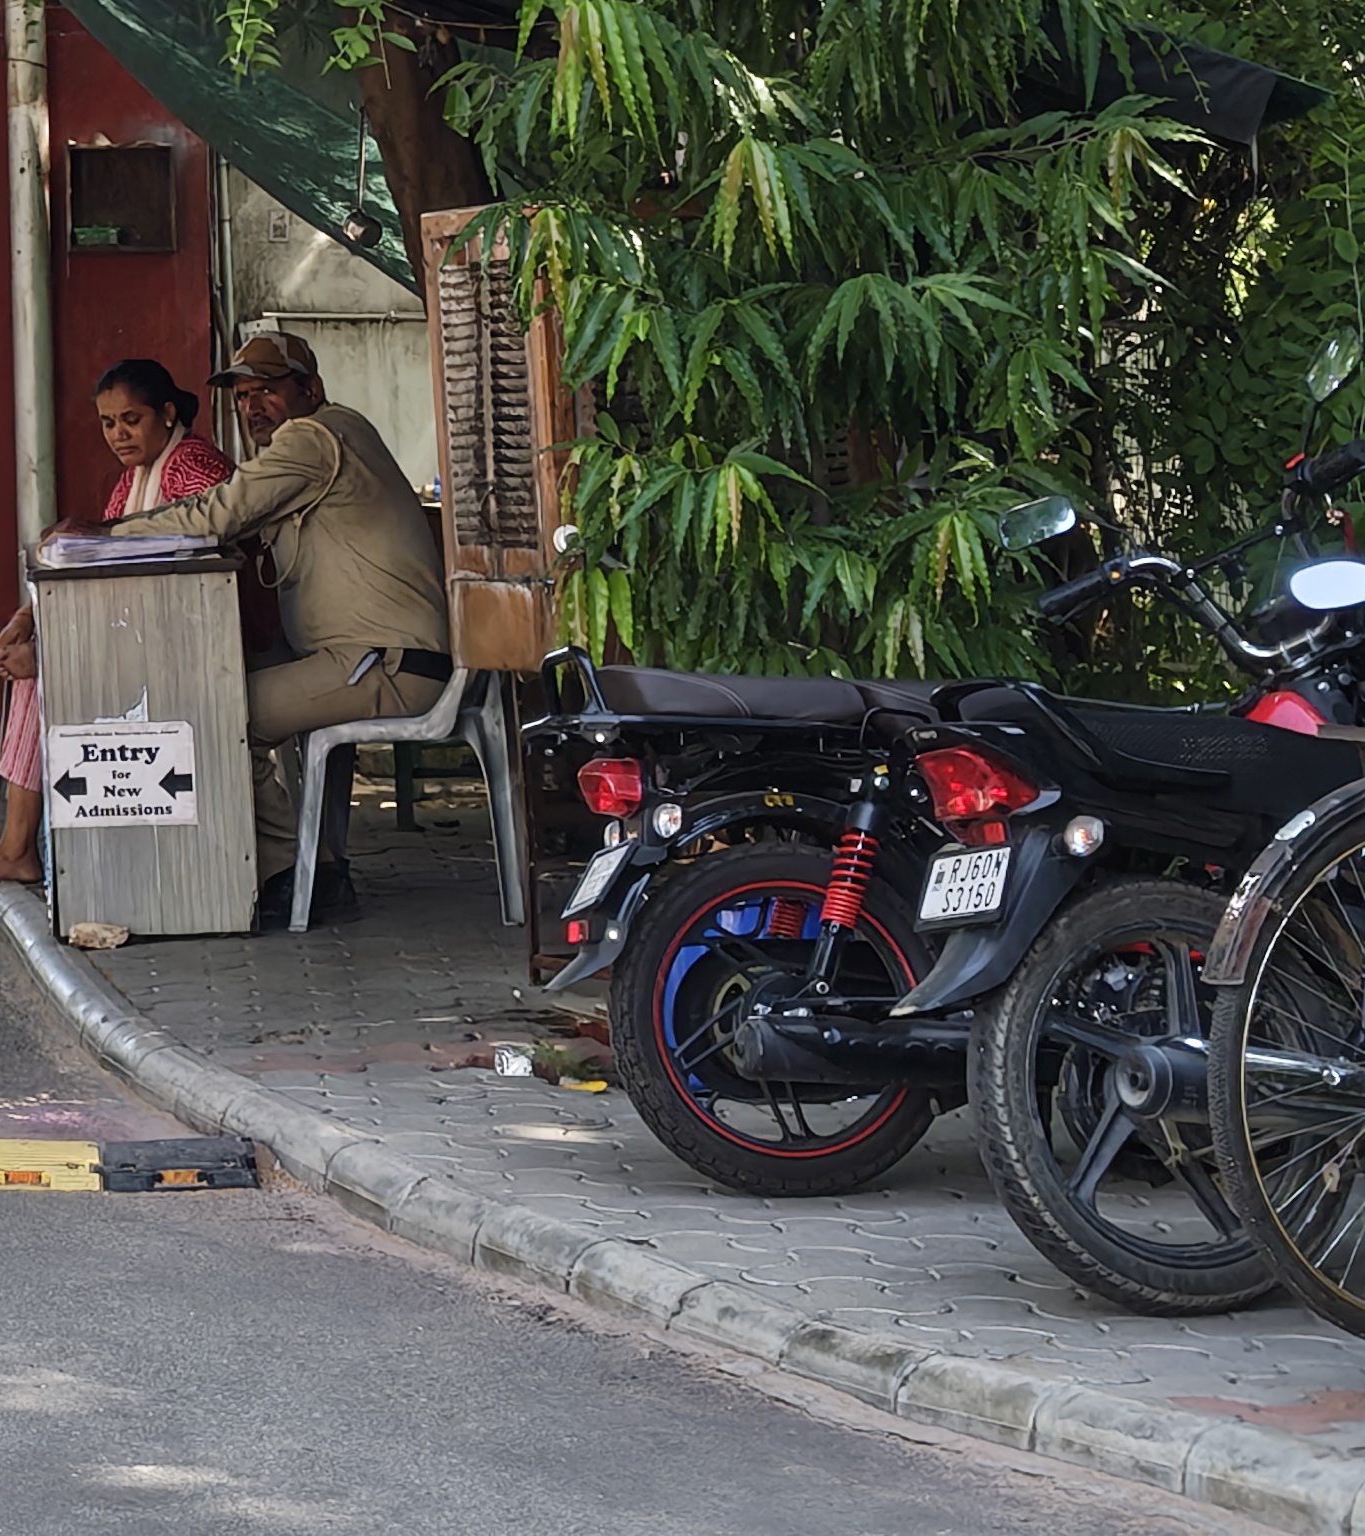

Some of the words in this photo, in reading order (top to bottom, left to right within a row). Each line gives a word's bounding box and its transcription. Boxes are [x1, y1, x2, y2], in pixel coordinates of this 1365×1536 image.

[80, 743, 161, 765] Entry
[111, 769, 132, 780] for
[102, 784, 143, 798] New
[74, 803, 173, 818] Admissions
[941, 881, 996, 913] S3150
